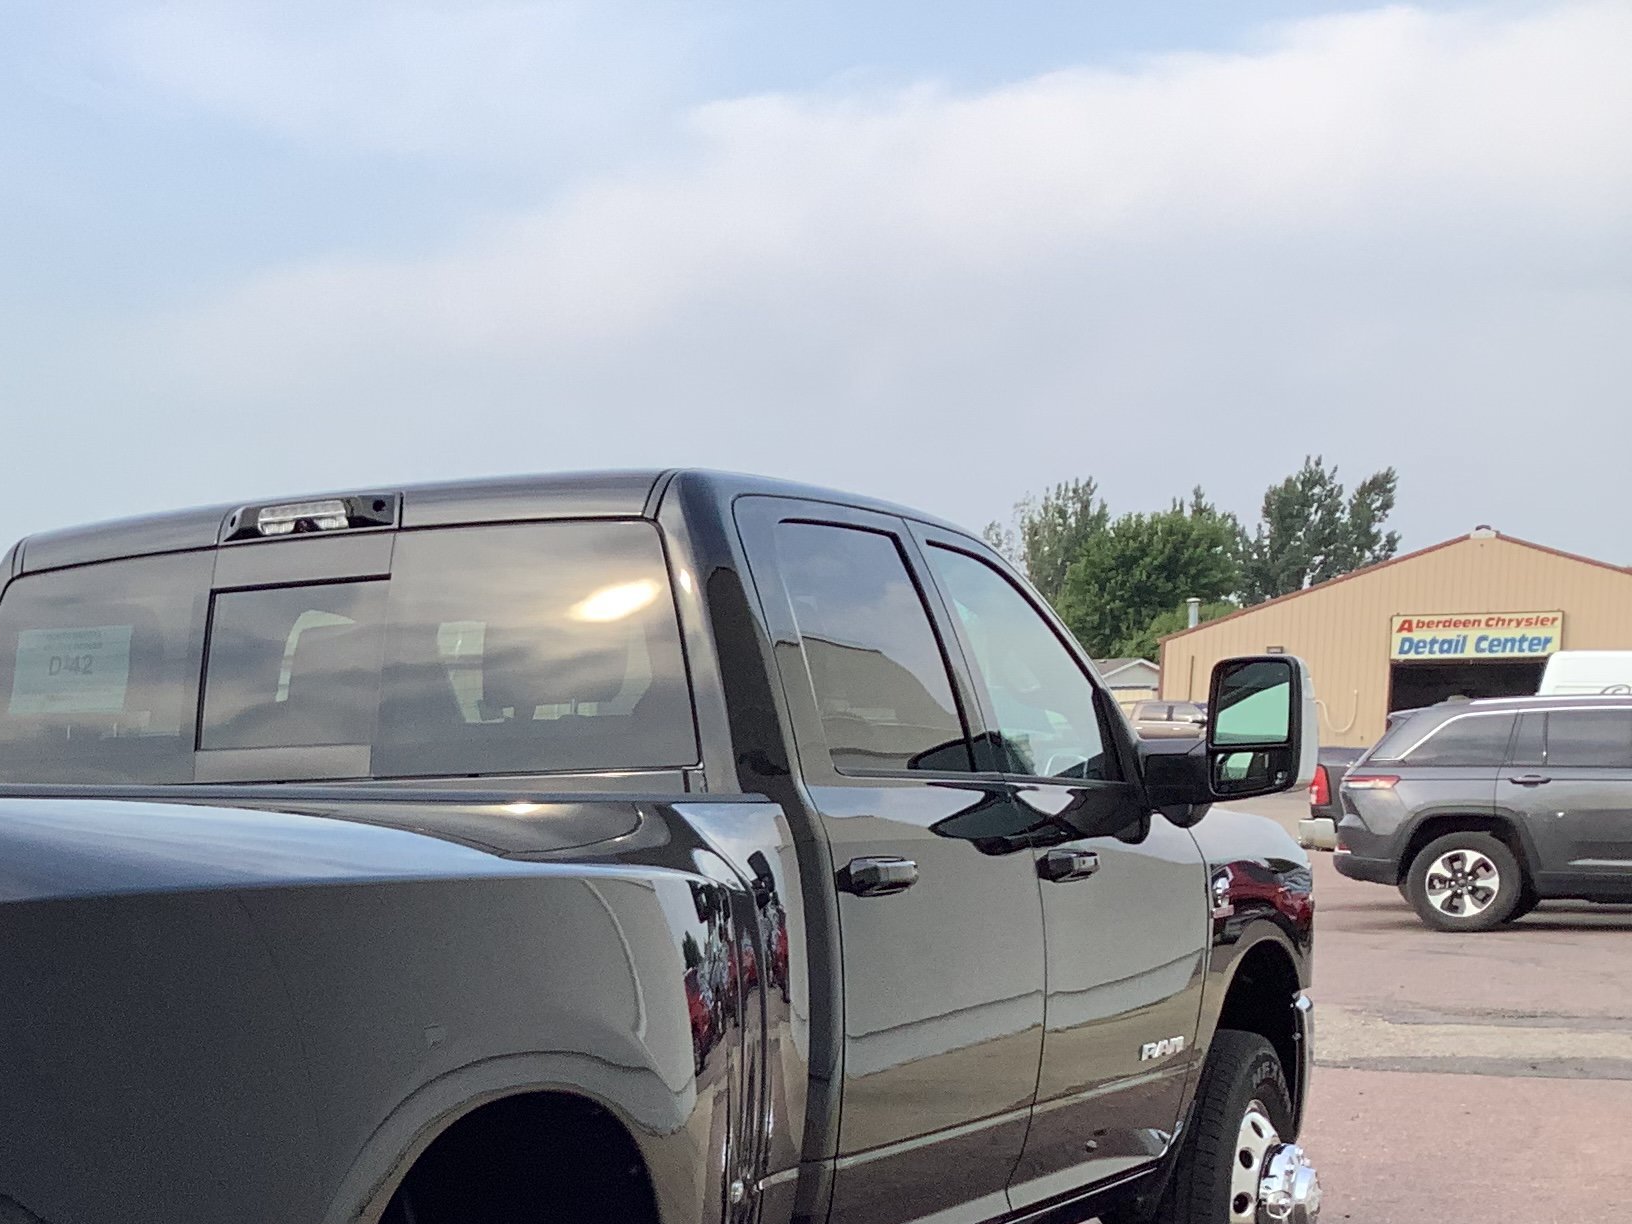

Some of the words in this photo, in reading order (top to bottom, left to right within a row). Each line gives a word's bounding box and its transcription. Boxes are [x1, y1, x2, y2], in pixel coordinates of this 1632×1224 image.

[1396, 617, 1481, 633] Aberdeen
[1485, 615, 1559, 629] Chrysler
[1398, 634, 1468, 655] Detail
[1474, 634, 1553, 654] Center
[1140, 1035, 1185, 1061] RAM
